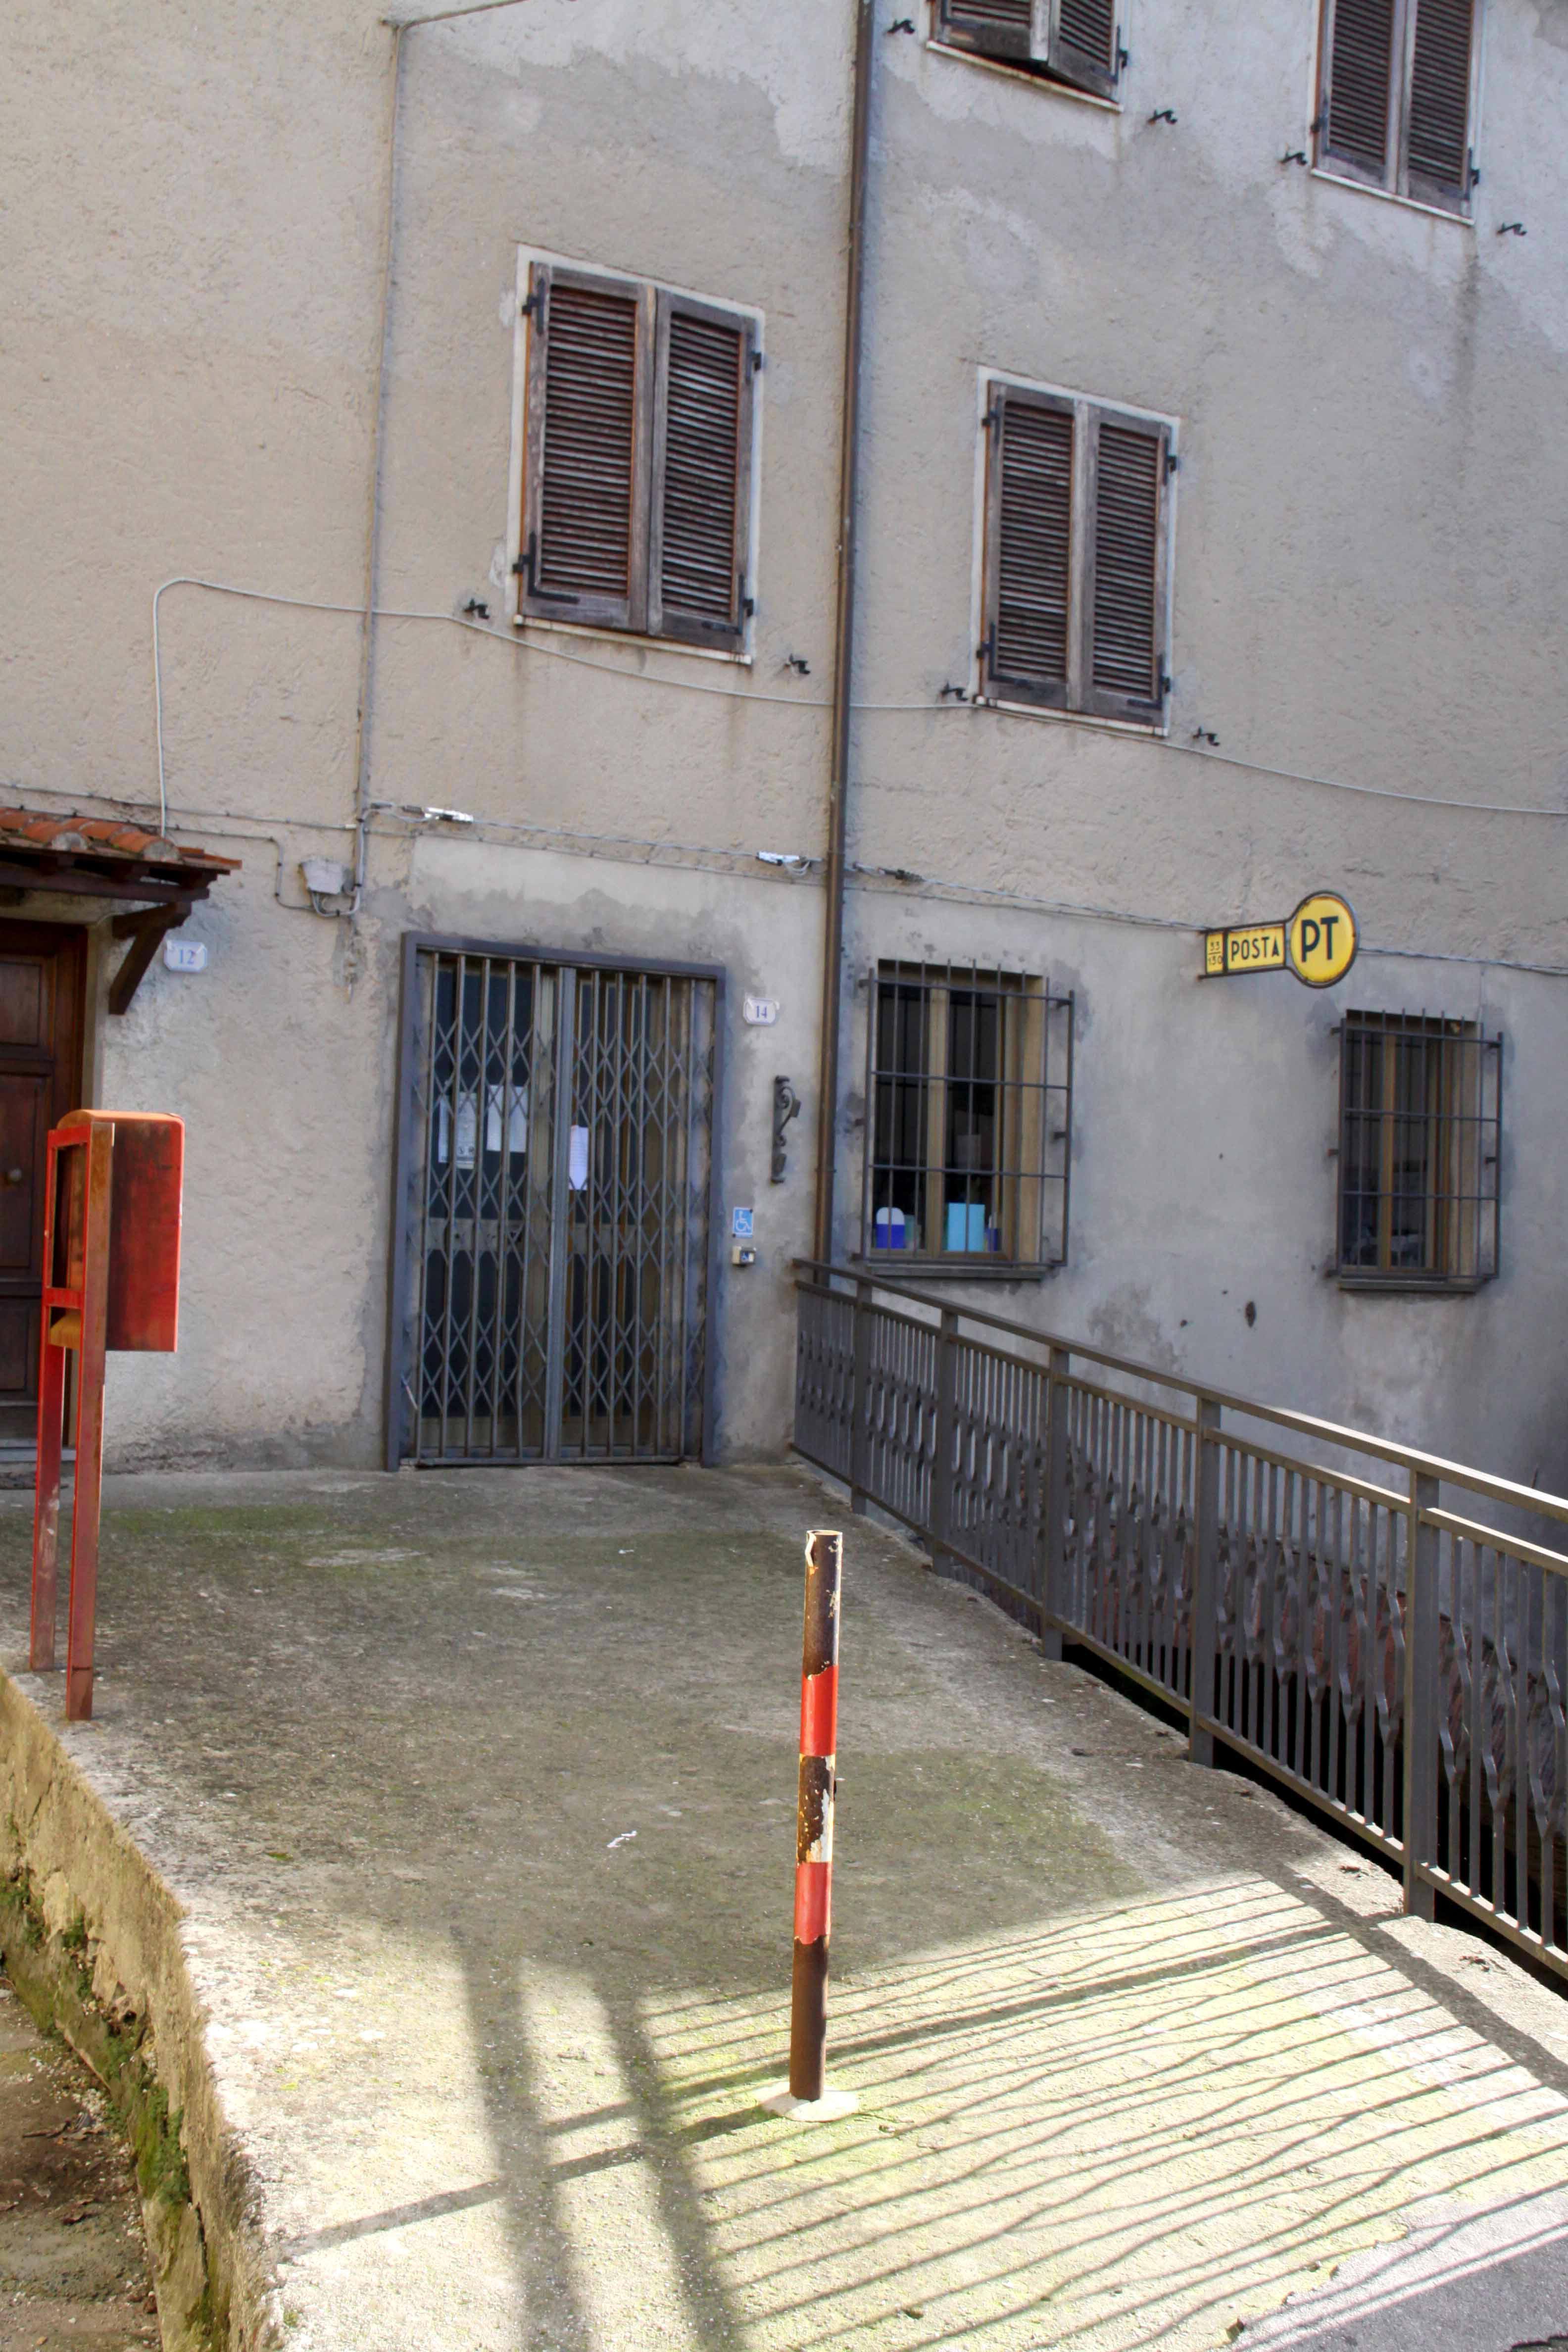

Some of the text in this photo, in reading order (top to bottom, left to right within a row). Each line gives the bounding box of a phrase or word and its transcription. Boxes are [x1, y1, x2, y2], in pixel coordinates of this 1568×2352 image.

[1231, 936, 1279, 961] POSTA
[1301, 916, 1339, 962] PT
[179, 950, 196, 964] 12
[756, 1005, 767, 1018] 14
